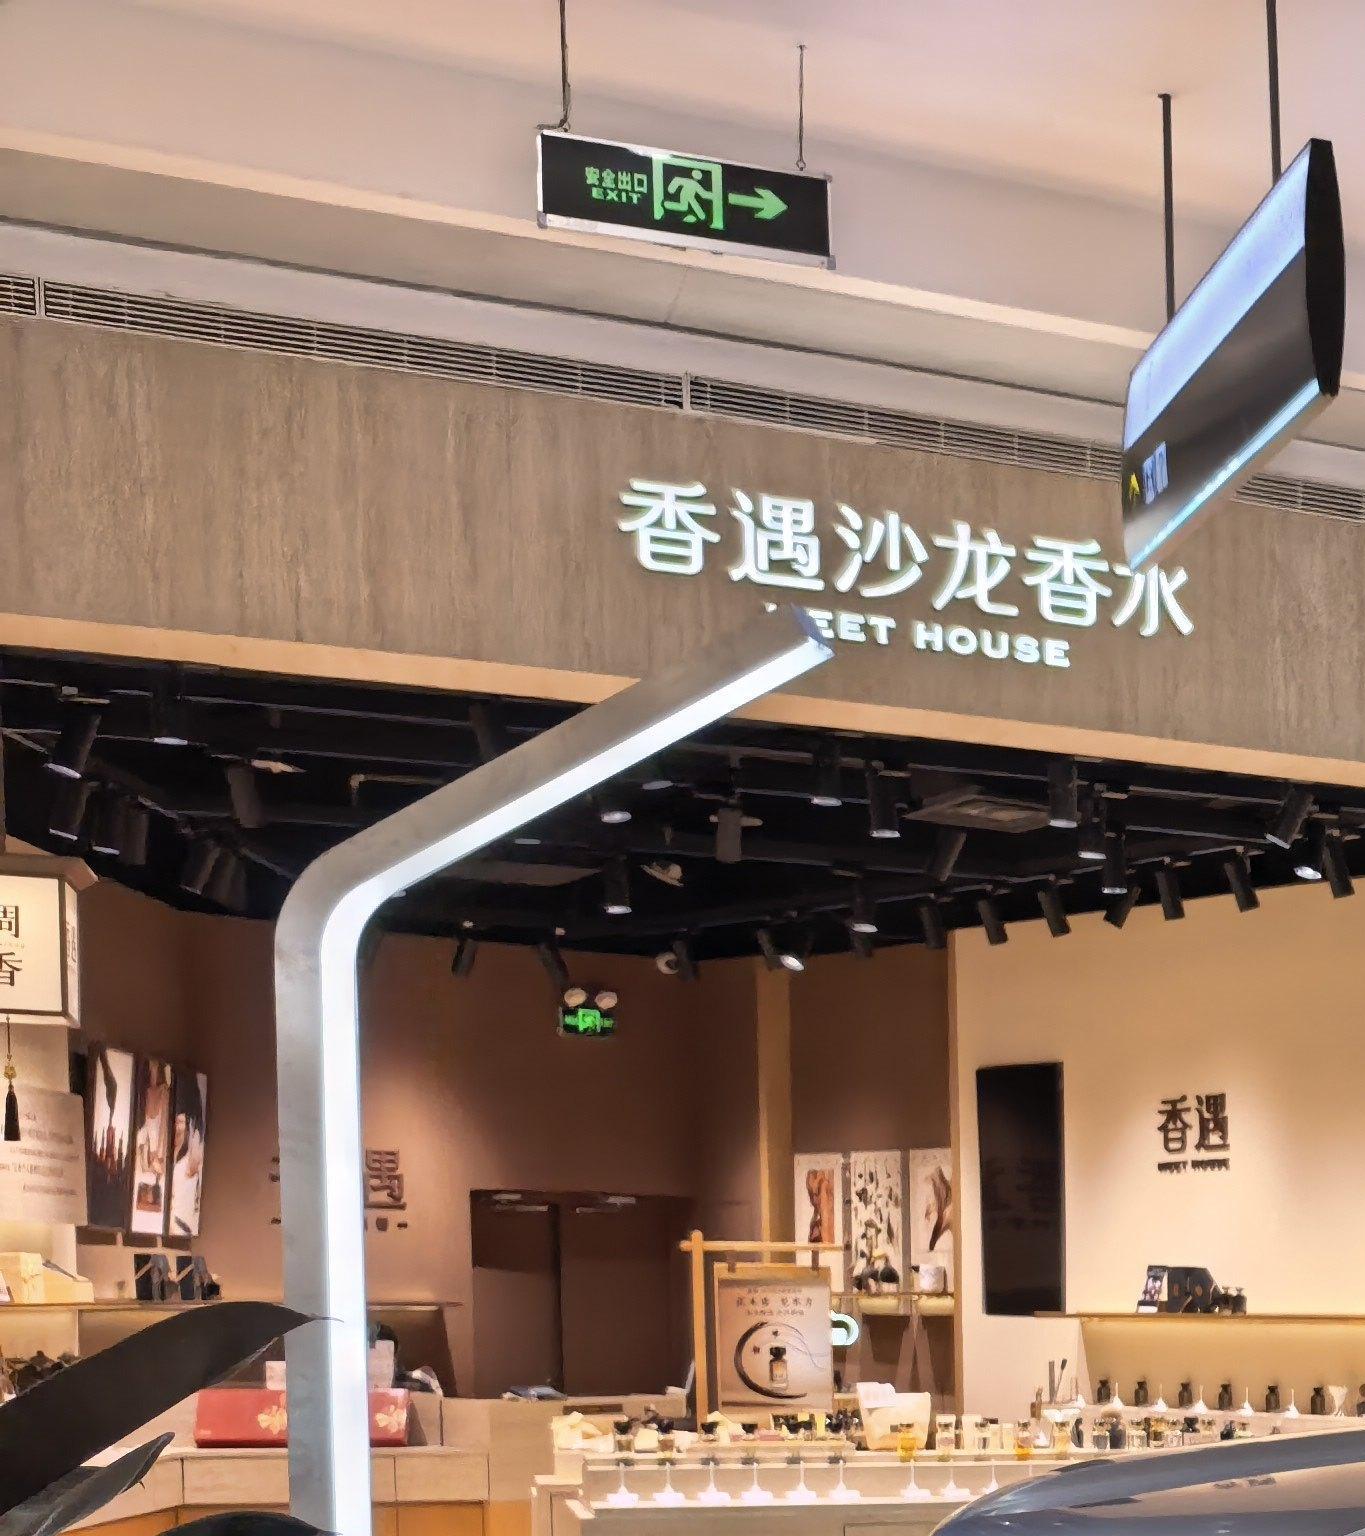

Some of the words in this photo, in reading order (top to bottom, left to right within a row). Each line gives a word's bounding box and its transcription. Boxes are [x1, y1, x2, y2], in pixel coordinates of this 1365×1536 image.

[591, 187, 641, 204] EXIT
[618, 477, 1195, 637] 香遇沙龙香水
[757, 602, 896, 645] EET
[912, 620, 1071, 668] HOUSE
[1157, 1093, 1231, 1154] 香遇
